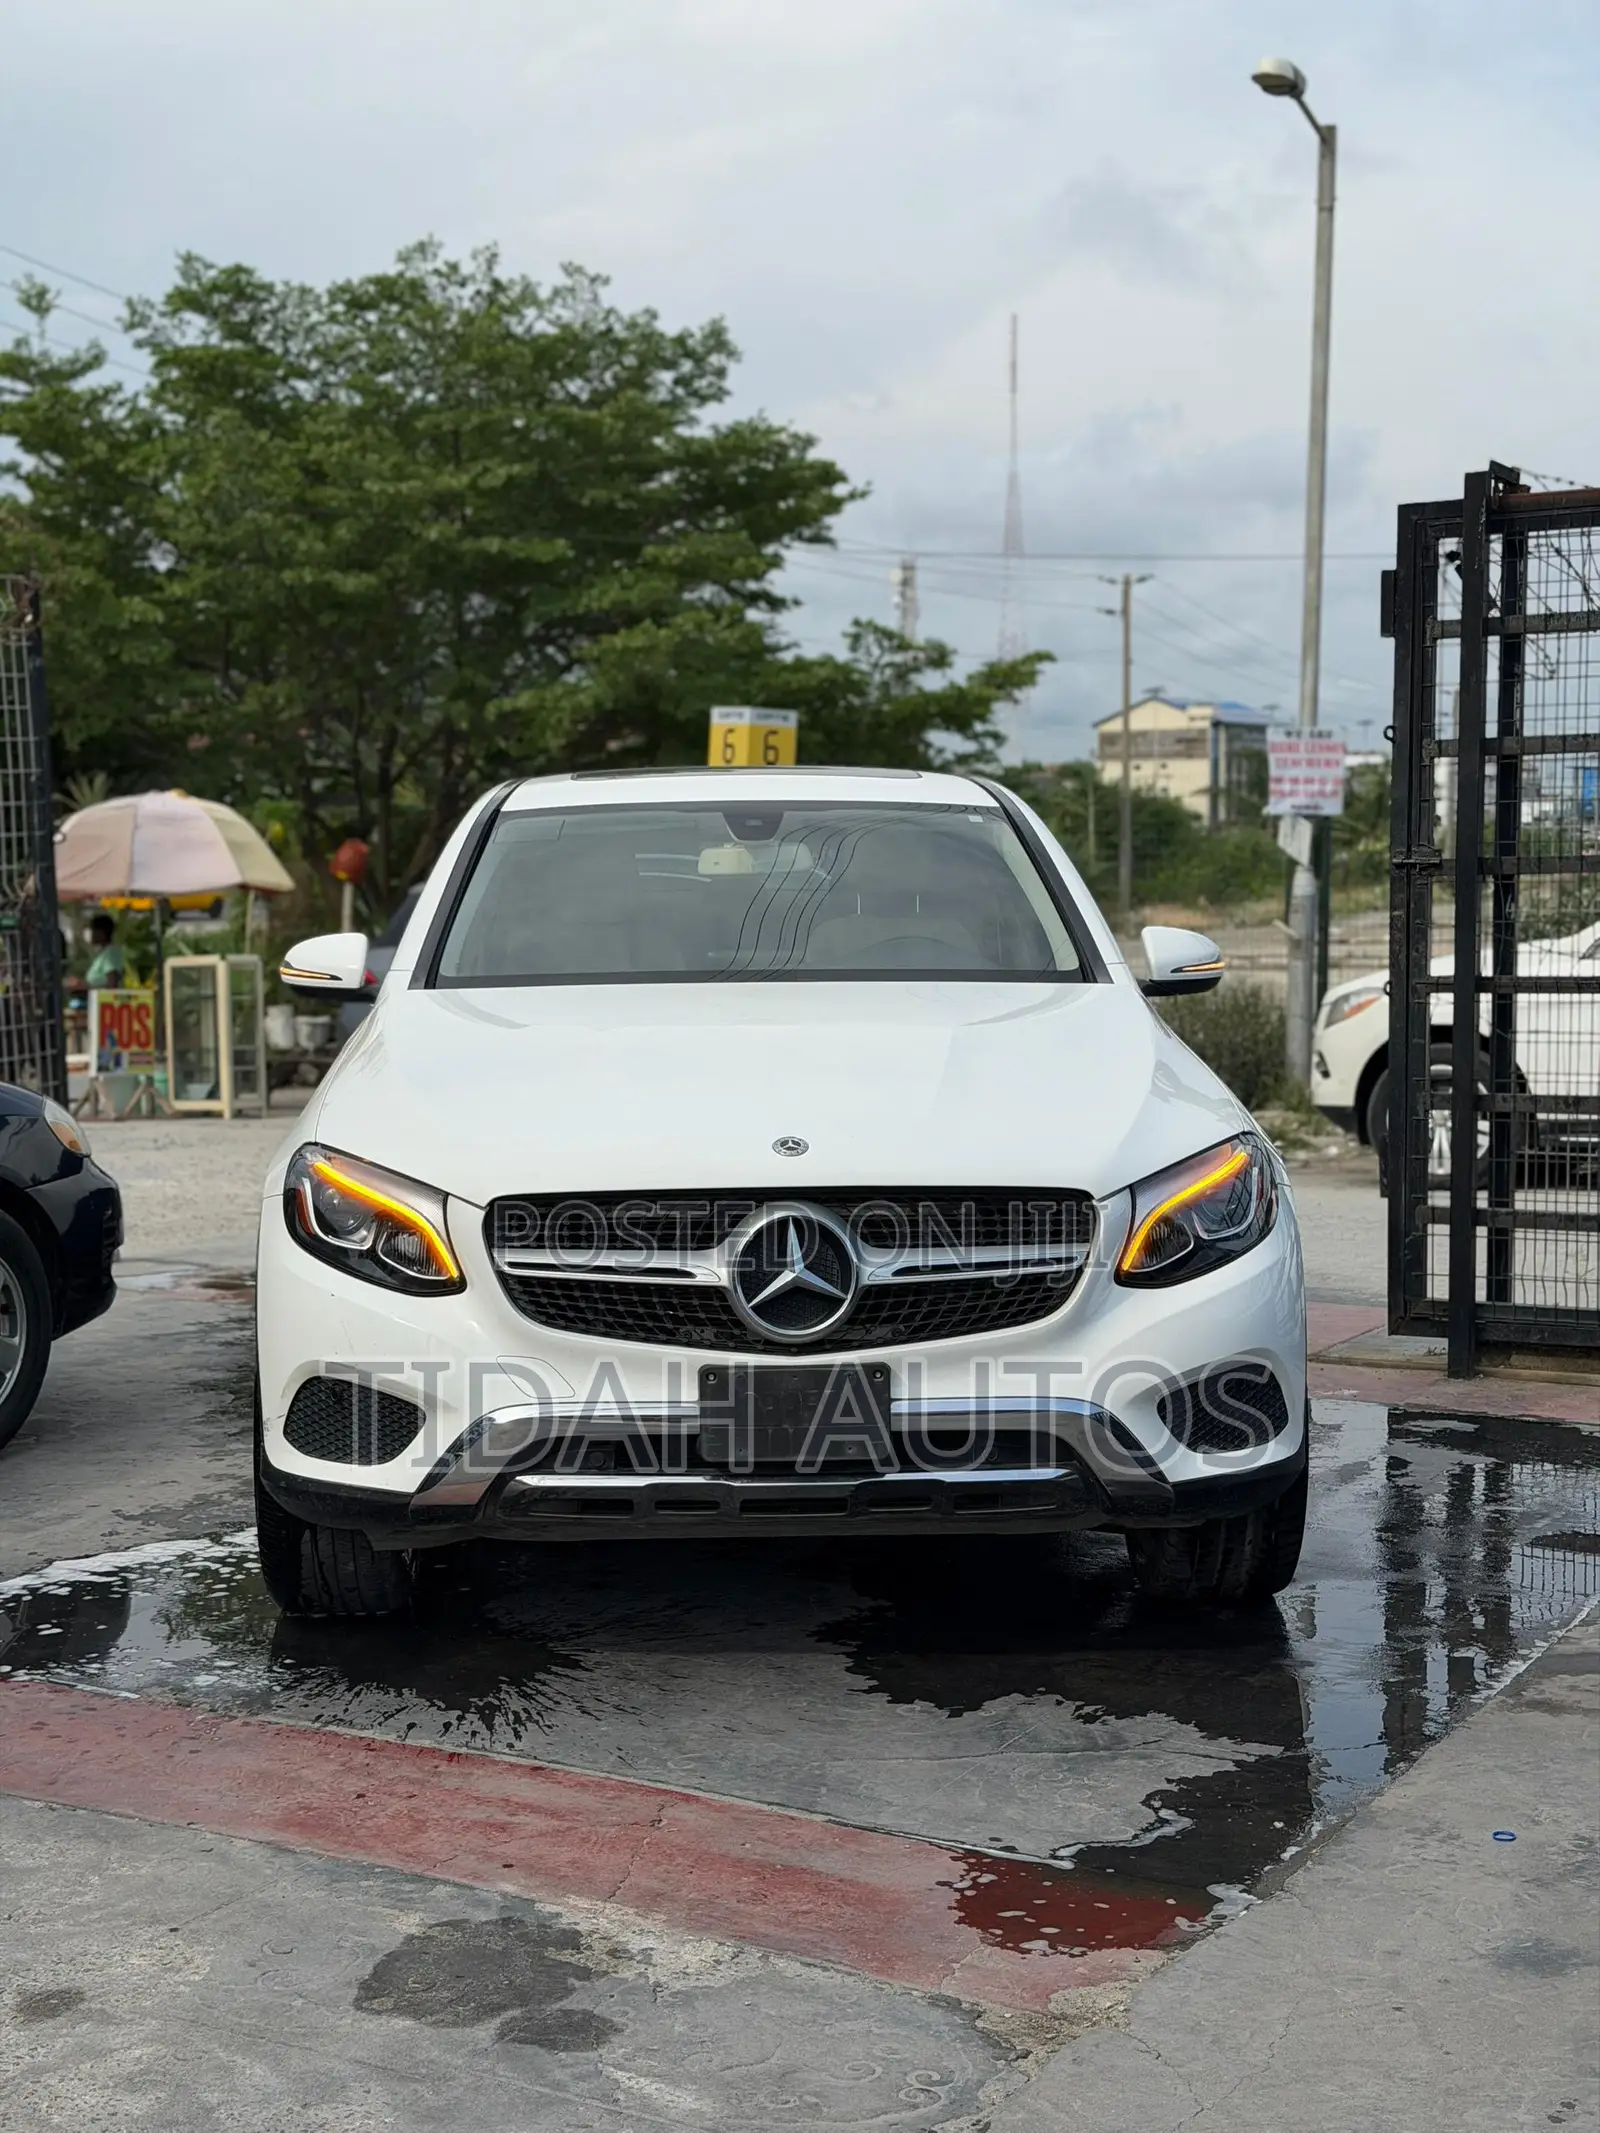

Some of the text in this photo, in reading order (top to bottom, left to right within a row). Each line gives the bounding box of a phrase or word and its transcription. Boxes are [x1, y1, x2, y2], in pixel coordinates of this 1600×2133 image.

[722, 727, 735, 764] 6
[762, 729, 780, 766] 6
[101, 1003, 152, 1050] POS
